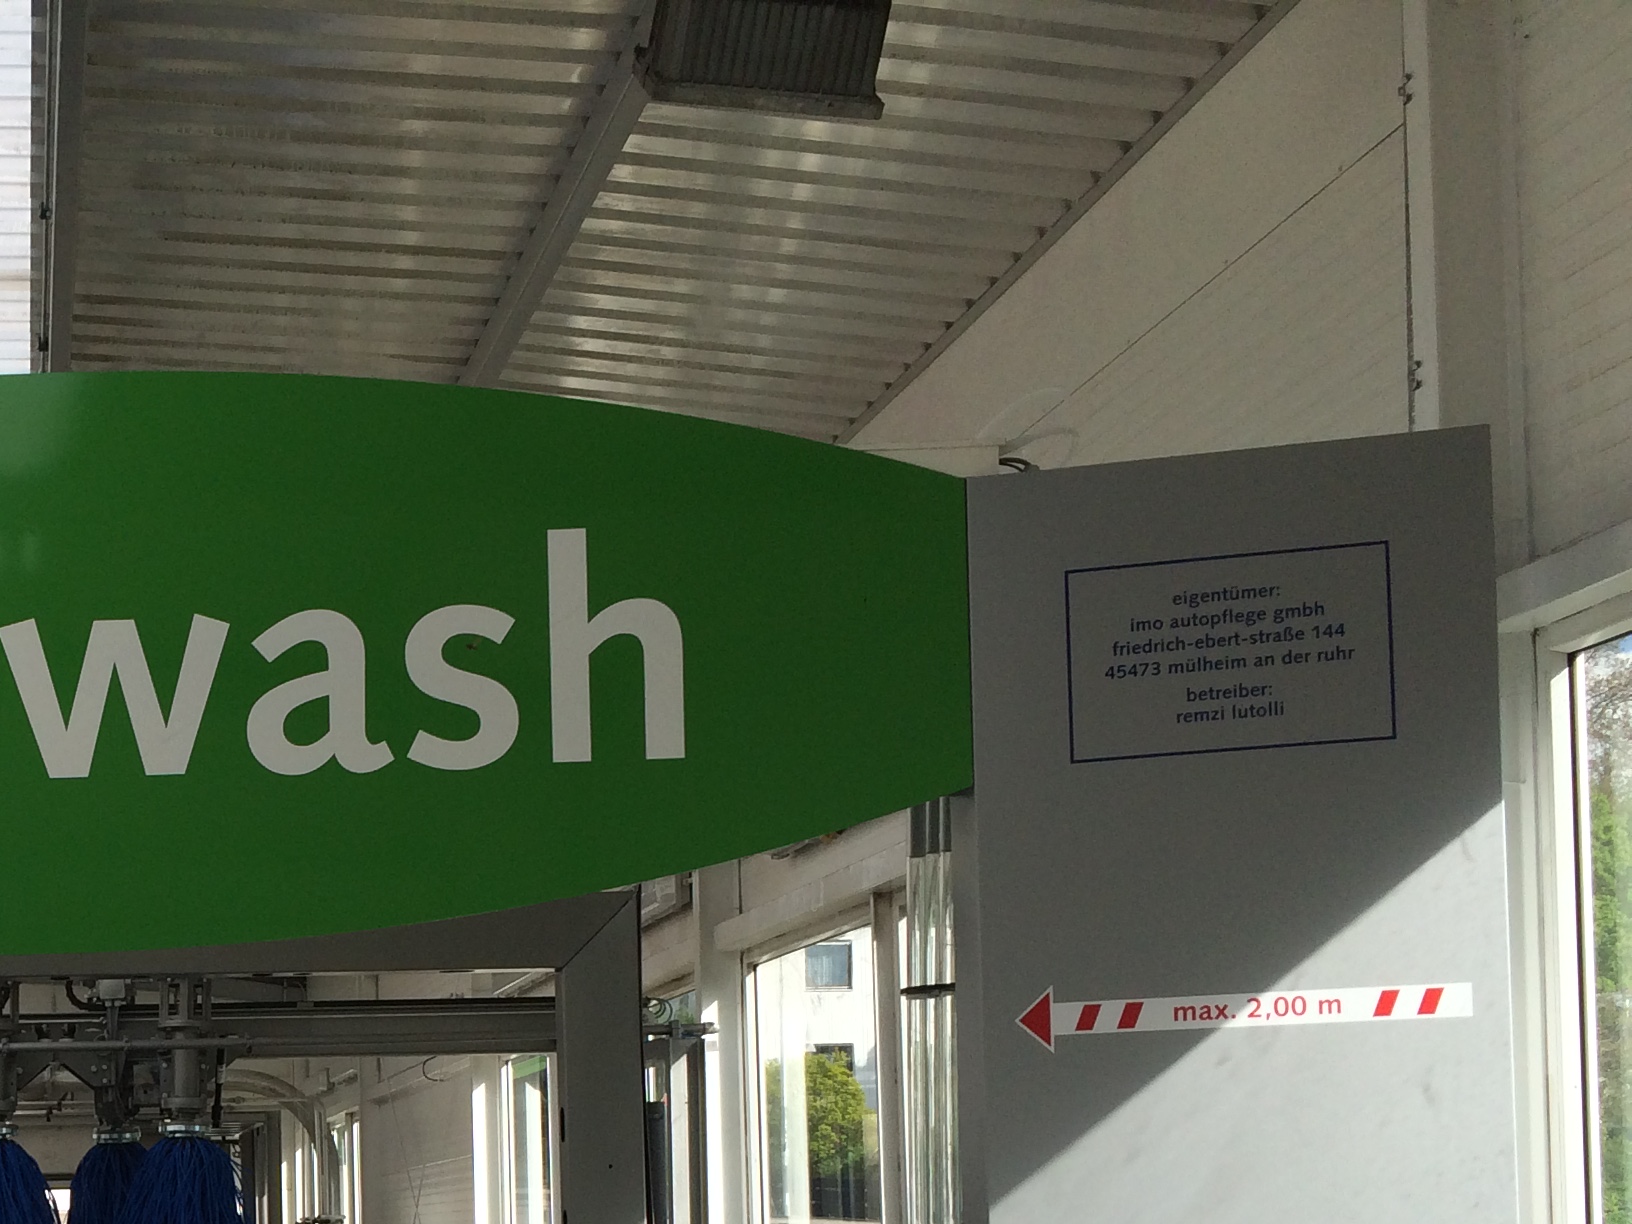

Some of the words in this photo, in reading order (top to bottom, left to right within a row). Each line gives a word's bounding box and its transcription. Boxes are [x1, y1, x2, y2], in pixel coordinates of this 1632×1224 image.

[1171, 584, 1281, 608] eigentümer:
[1130, 617, 1163, 633] imo
[1170, 608, 1267, 633] autopflege
[1273, 602, 1326, 623] gmbh
[1112, 625, 1305, 657] friedrich-ebert-straße
[1312, 623, 1346, 640] 144
[1104, 661, 1162, 680] 45473
[1168, 653, 1247, 675] mülheim
[1253, 654, 1276, 667] an
[1281, 648, 1311, 667] der
[1317, 645, 1355, 663] ruhr
[1186, 683, 1273, 702] betreiber:
[1176, 706, 1226, 724] remzi
[1173, 1000, 1237, 1022] max.
[1247, 996, 1306, 1021] 2,00
[1319, 997, 1342, 1015] m
